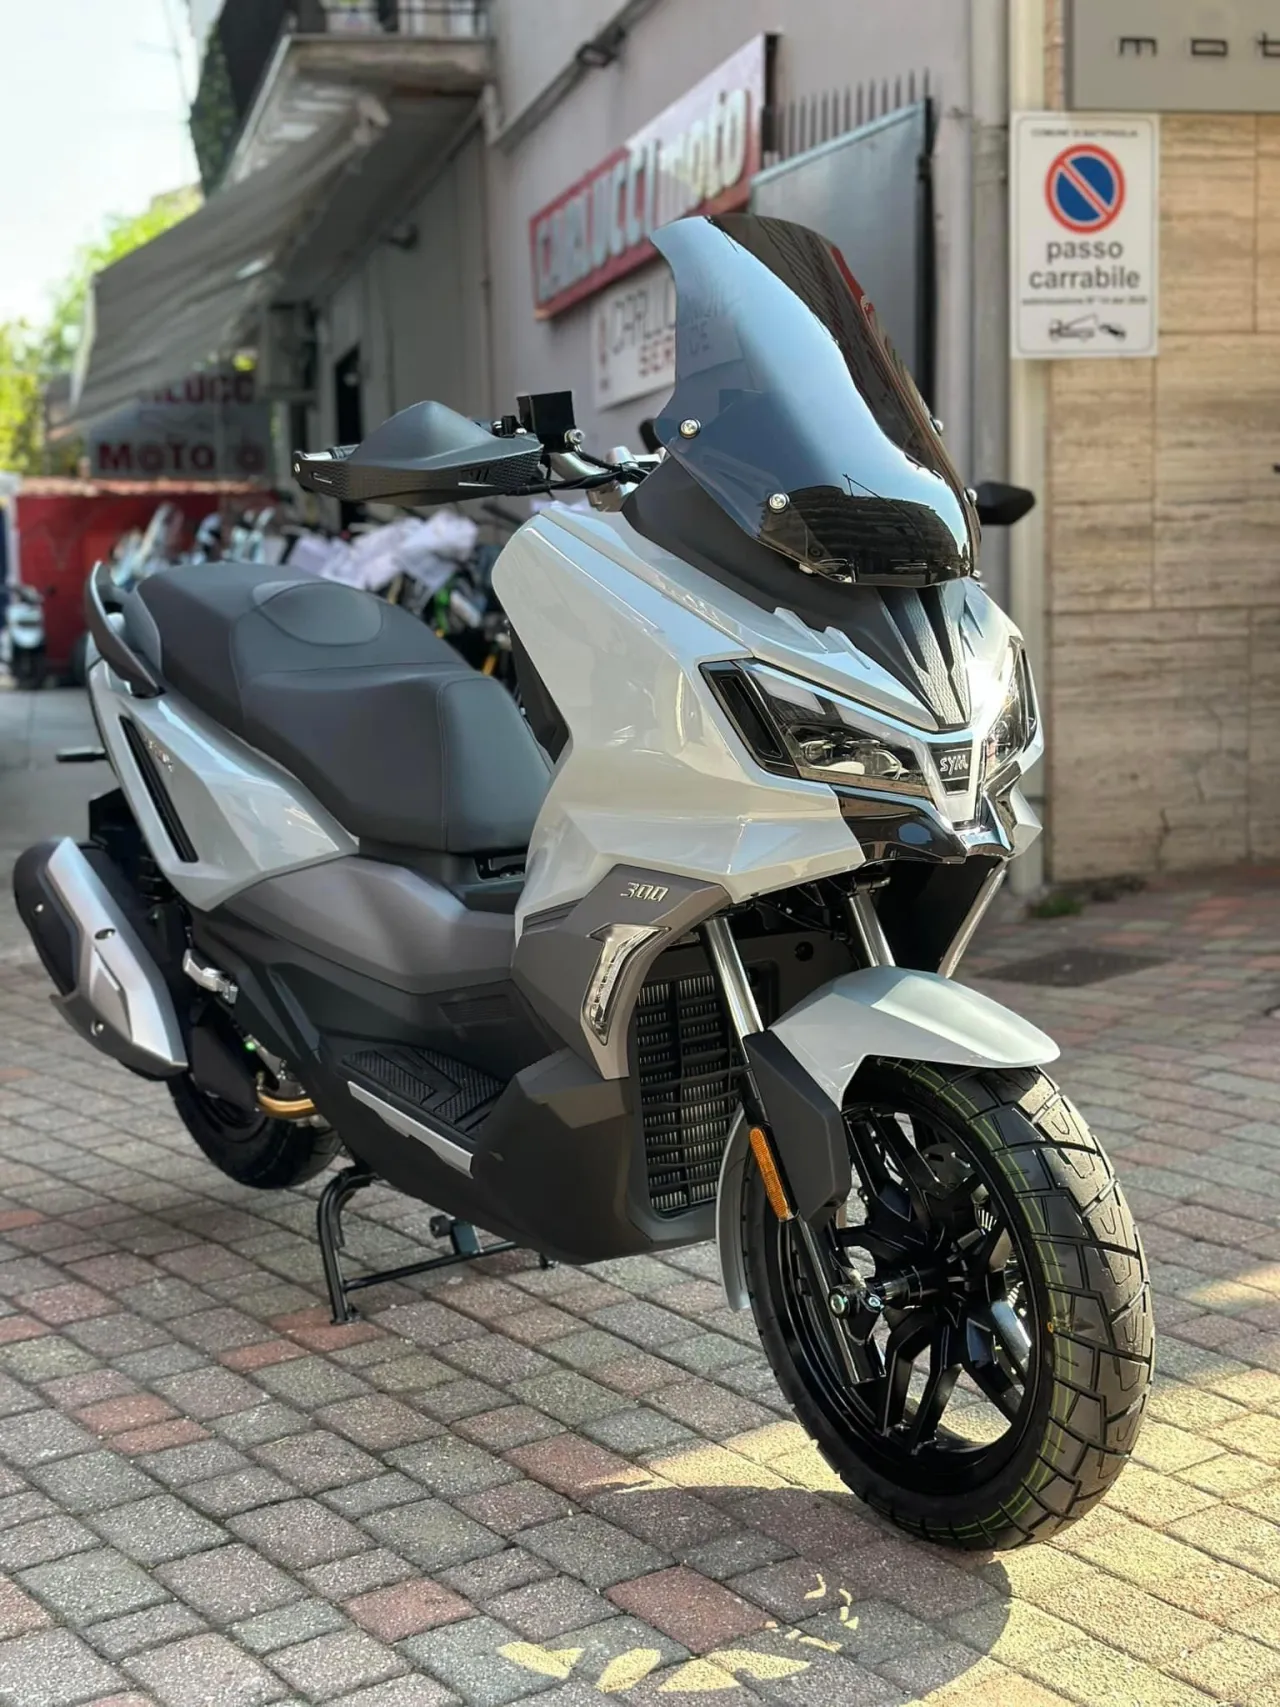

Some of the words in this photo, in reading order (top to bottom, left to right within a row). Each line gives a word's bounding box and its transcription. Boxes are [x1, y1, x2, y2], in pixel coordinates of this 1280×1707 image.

[1046, 241, 1124, 265] passo
[1028, 265, 1141, 289] carrabile
[939, 754, 969, 776] SYM
[620, 881, 669, 902] 300
